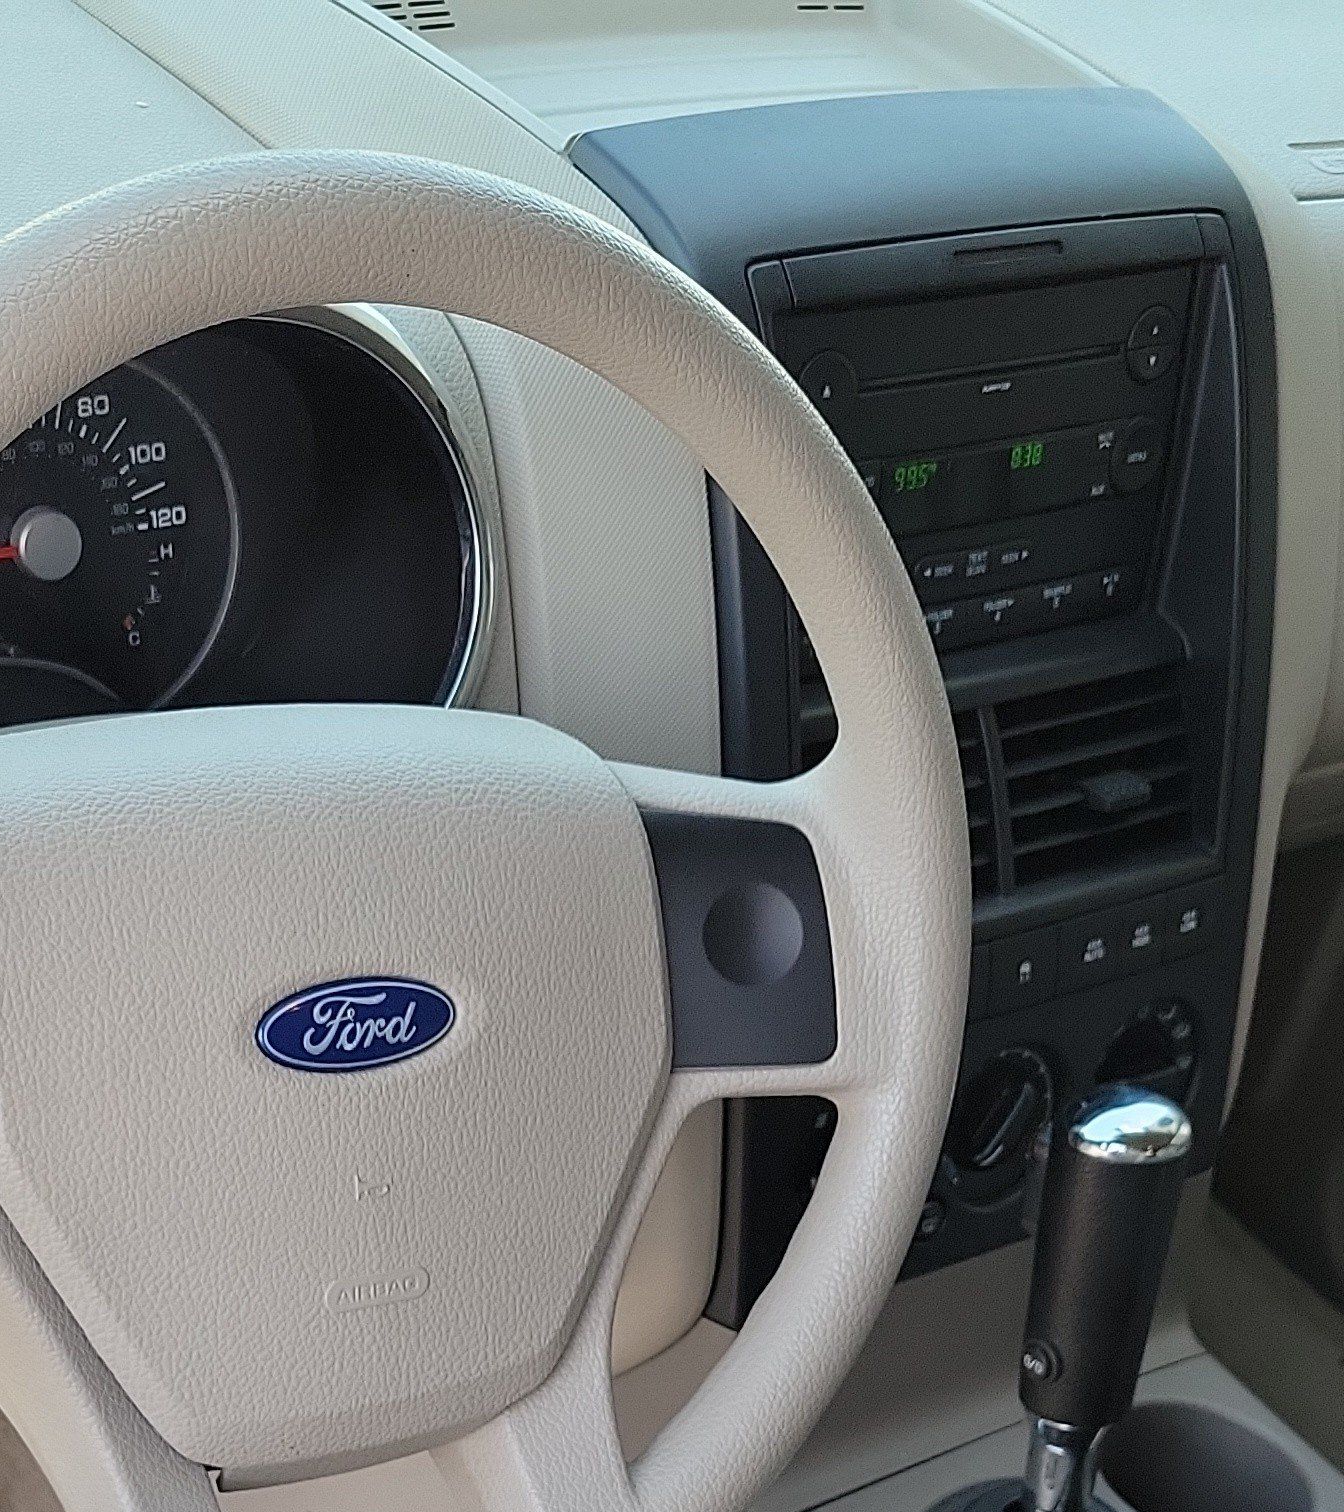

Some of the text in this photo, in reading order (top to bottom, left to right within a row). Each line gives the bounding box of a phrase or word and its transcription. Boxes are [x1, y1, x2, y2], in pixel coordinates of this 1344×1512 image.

[77, 395, 110, 417] 80
[127, 442, 166, 465] 100
[149, 505, 187, 529] 120
[160, 543, 173, 559] H
[303, 992, 417, 1056] Ford
[336, 1278, 422, 1303] AIRBAG
